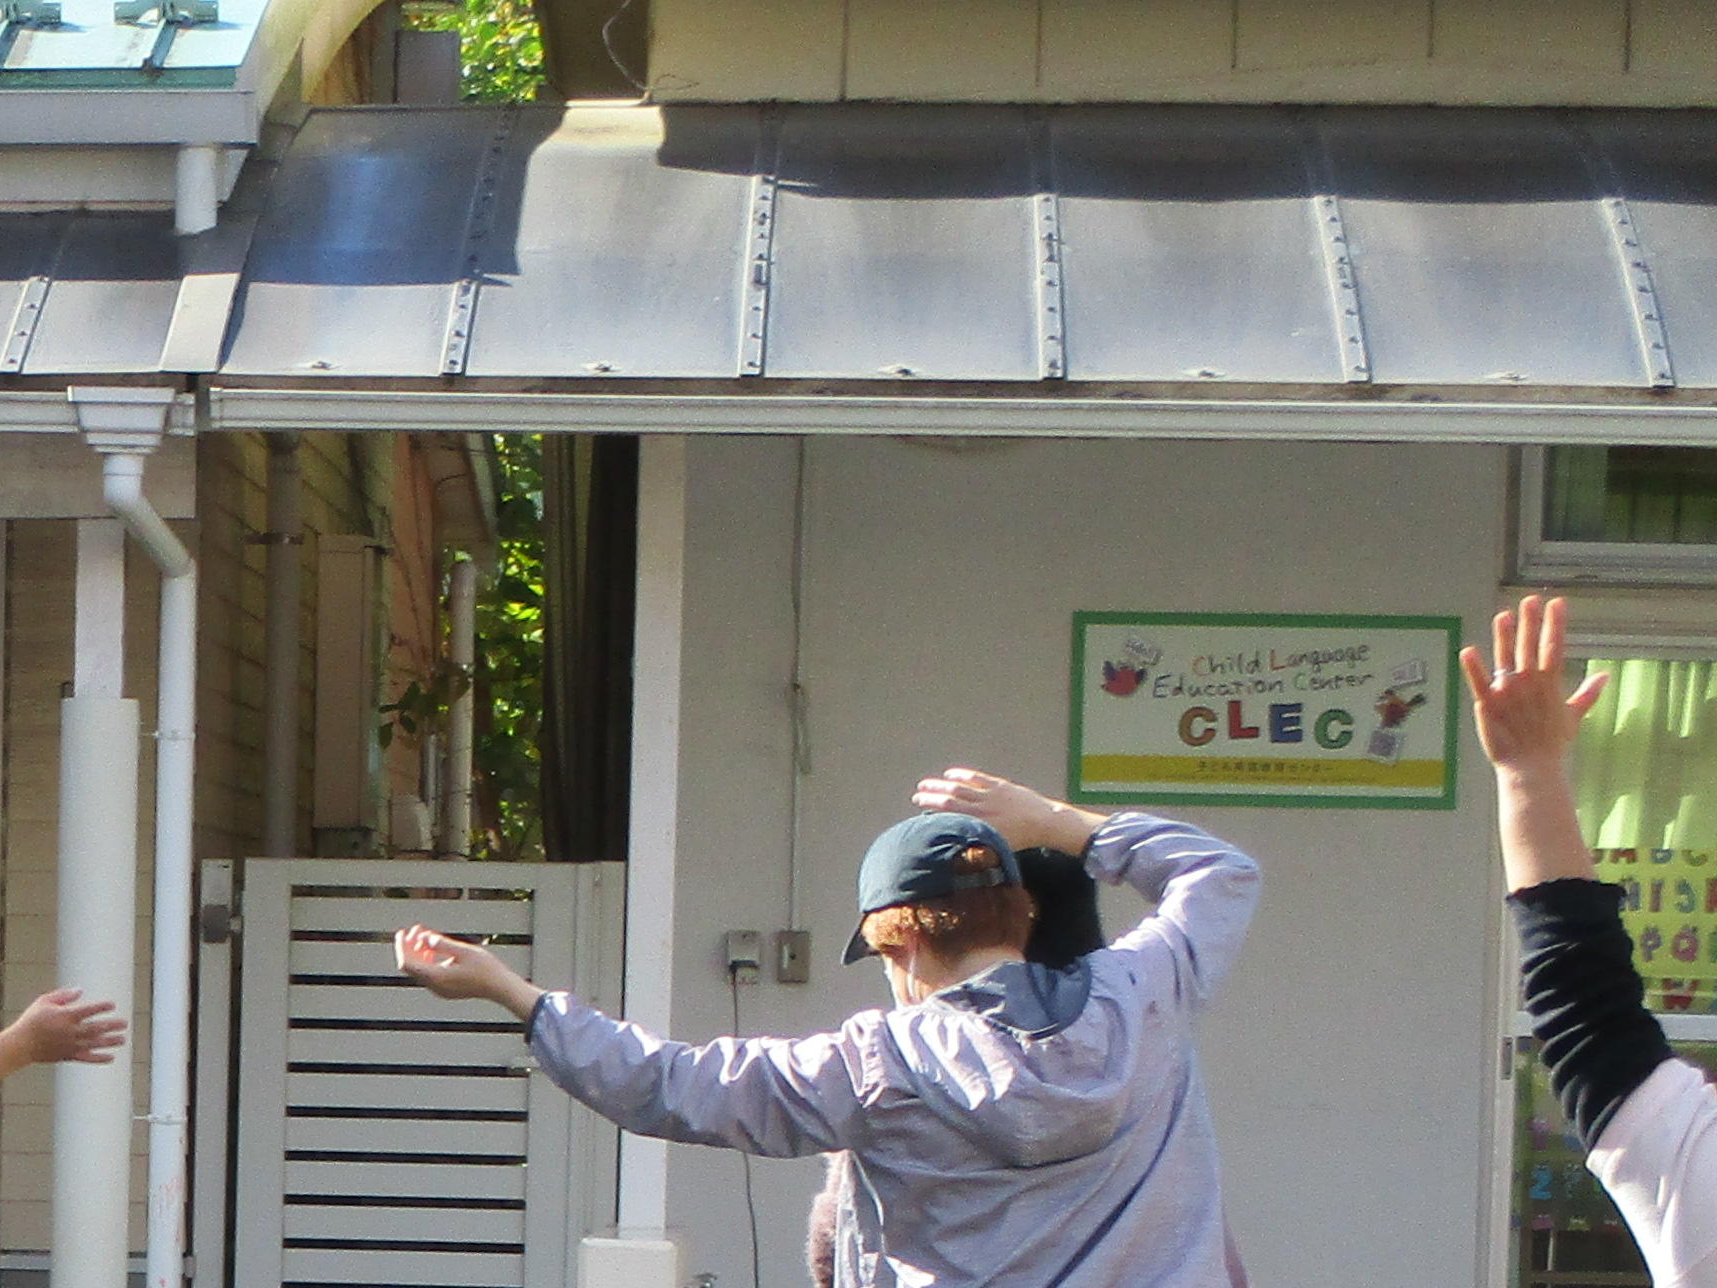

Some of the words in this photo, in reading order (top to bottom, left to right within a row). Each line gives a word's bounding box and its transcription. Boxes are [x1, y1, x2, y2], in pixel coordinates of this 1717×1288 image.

[1192, 651, 1262, 676] Child
[1269, 643, 1371, 673] Language
[1152, 673, 1286, 699] Education
[1293, 671, 1374, 693] Center
[1177, 699, 1354, 750] CLEC
